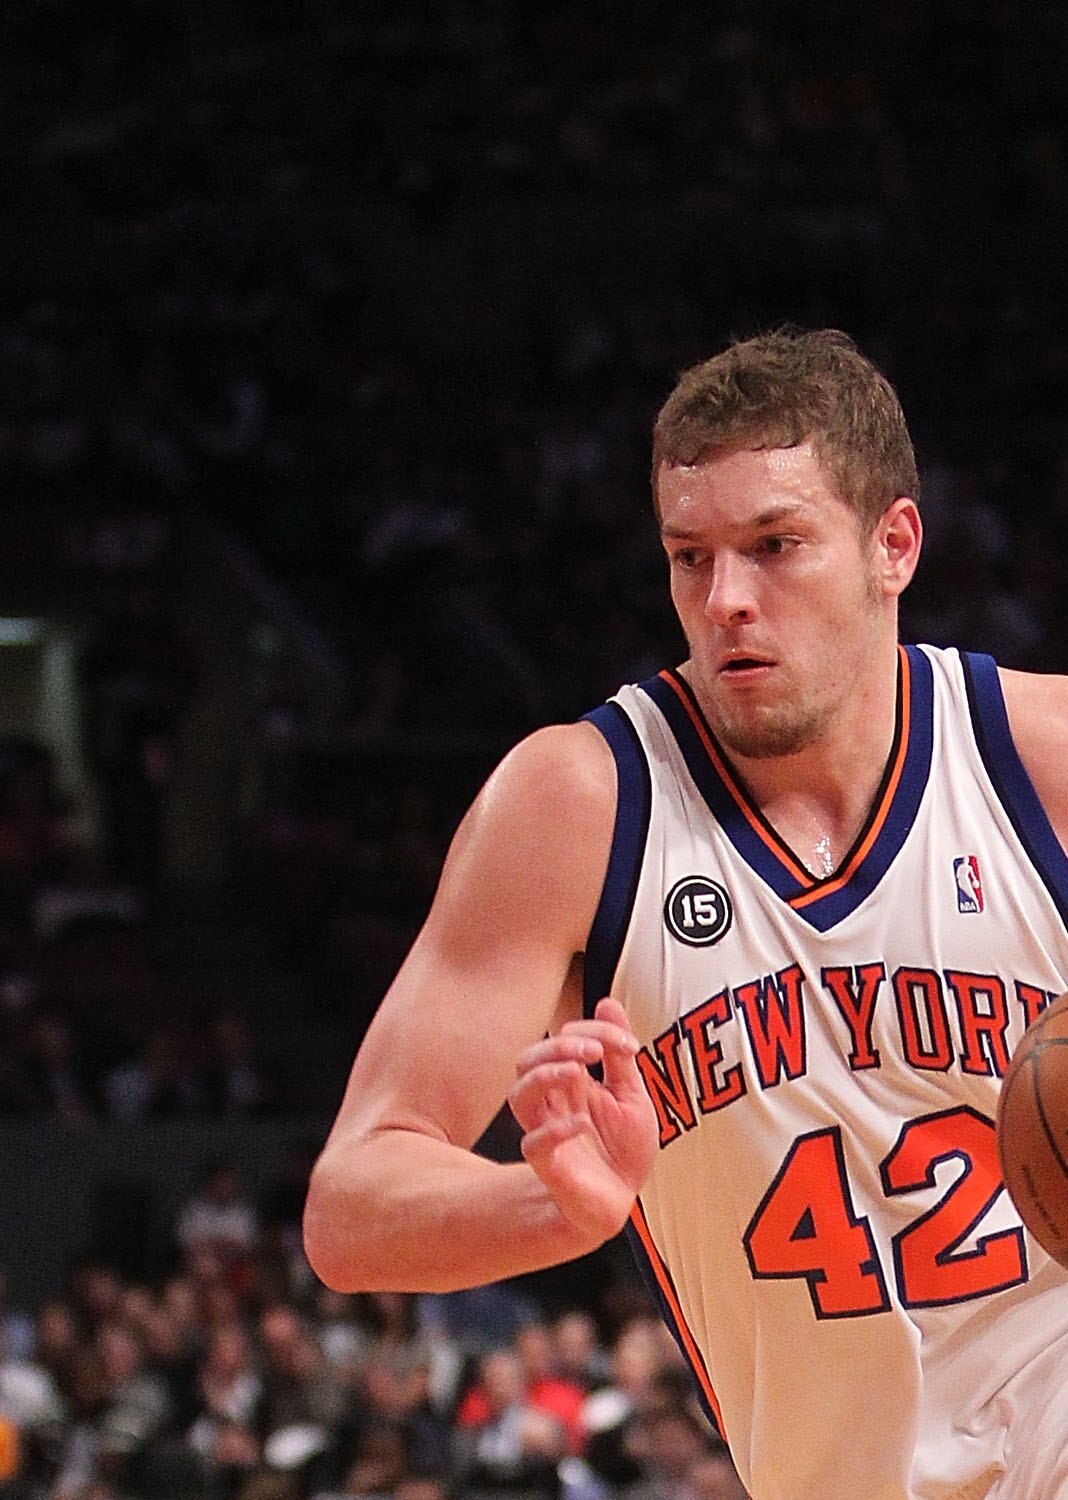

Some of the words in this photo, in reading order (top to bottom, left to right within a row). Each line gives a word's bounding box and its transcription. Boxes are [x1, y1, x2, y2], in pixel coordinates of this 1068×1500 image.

[681, 893, 718, 928] 15
[959, 900, 978, 912] NBA
[635, 963, 807, 1149] NEW
[821, 962, 1060, 1079] YOR
[742, 1104, 1029, 1321] 42
